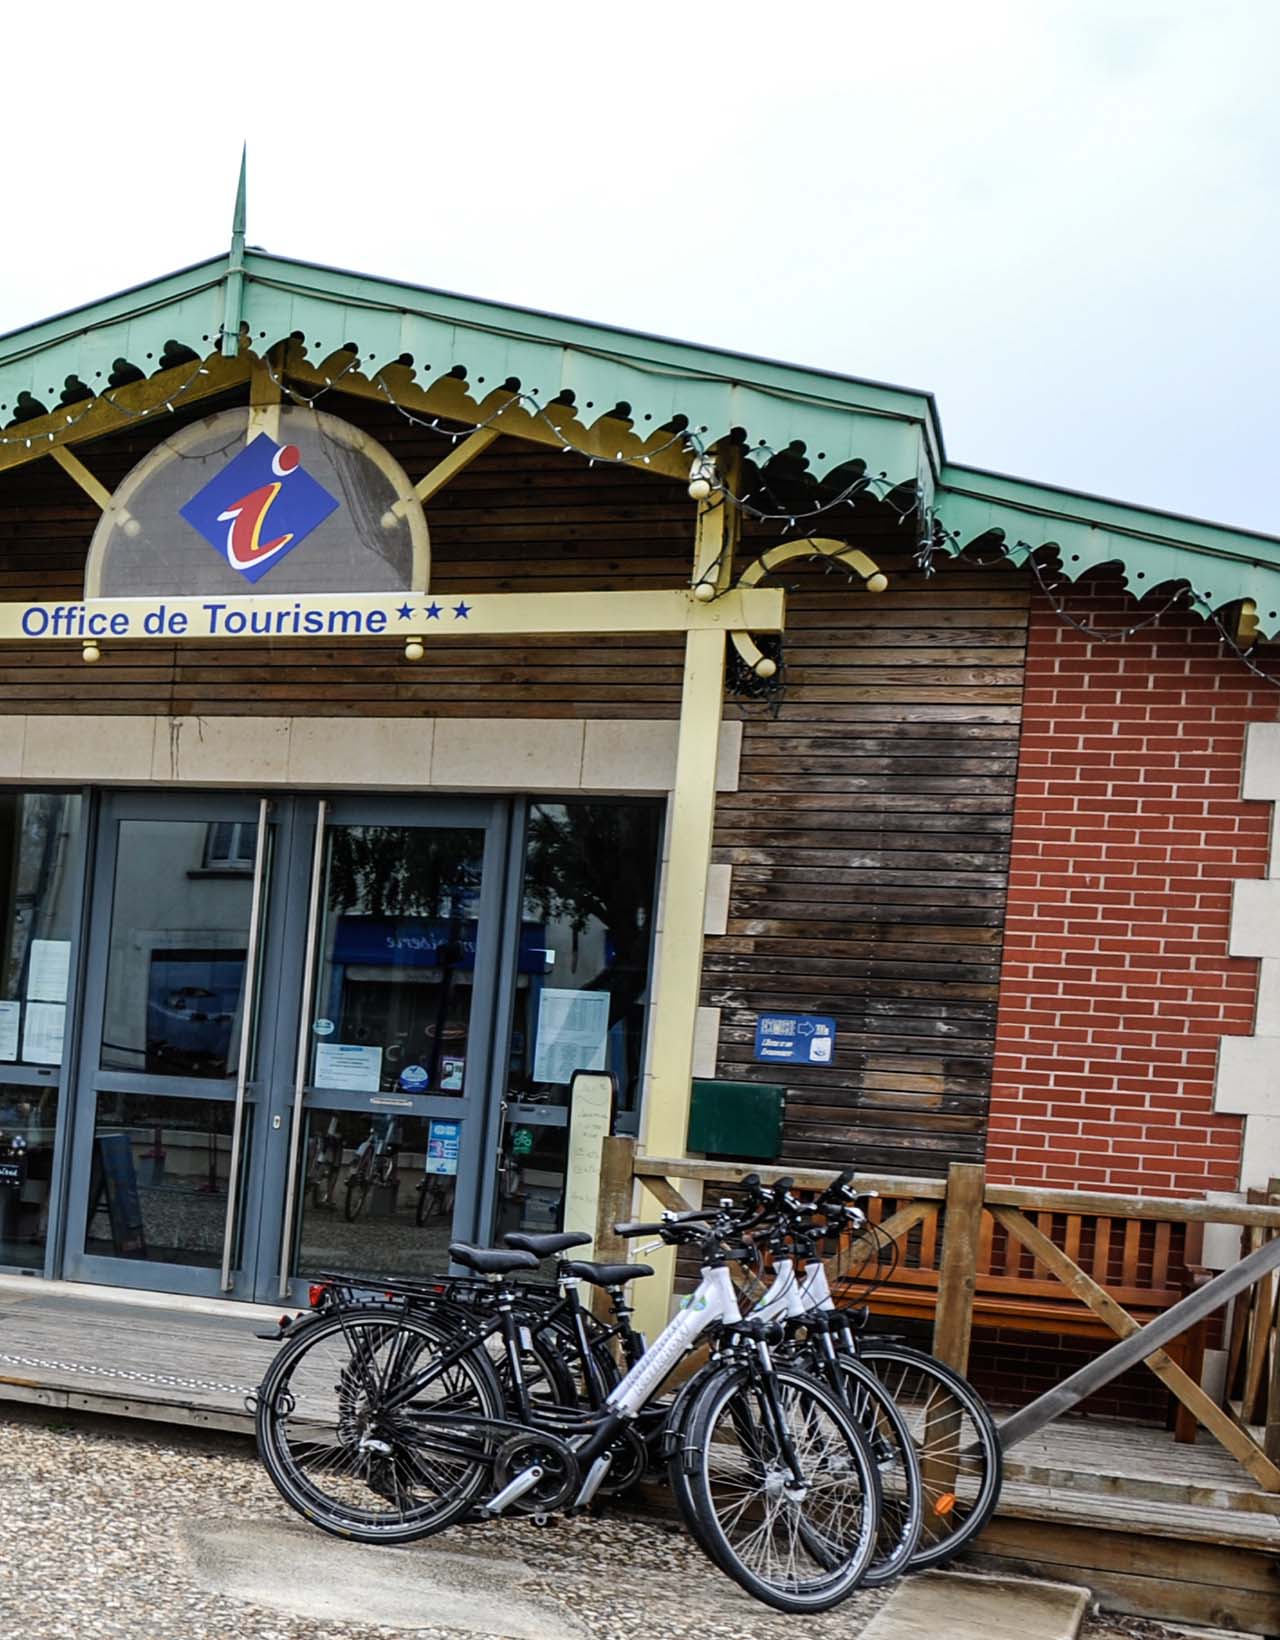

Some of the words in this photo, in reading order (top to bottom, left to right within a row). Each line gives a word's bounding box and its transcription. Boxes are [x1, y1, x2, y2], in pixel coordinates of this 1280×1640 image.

[21, 606, 130, 636] Office
[143, 604, 188, 635] de
[202, 603, 388, 635] Tourisme
